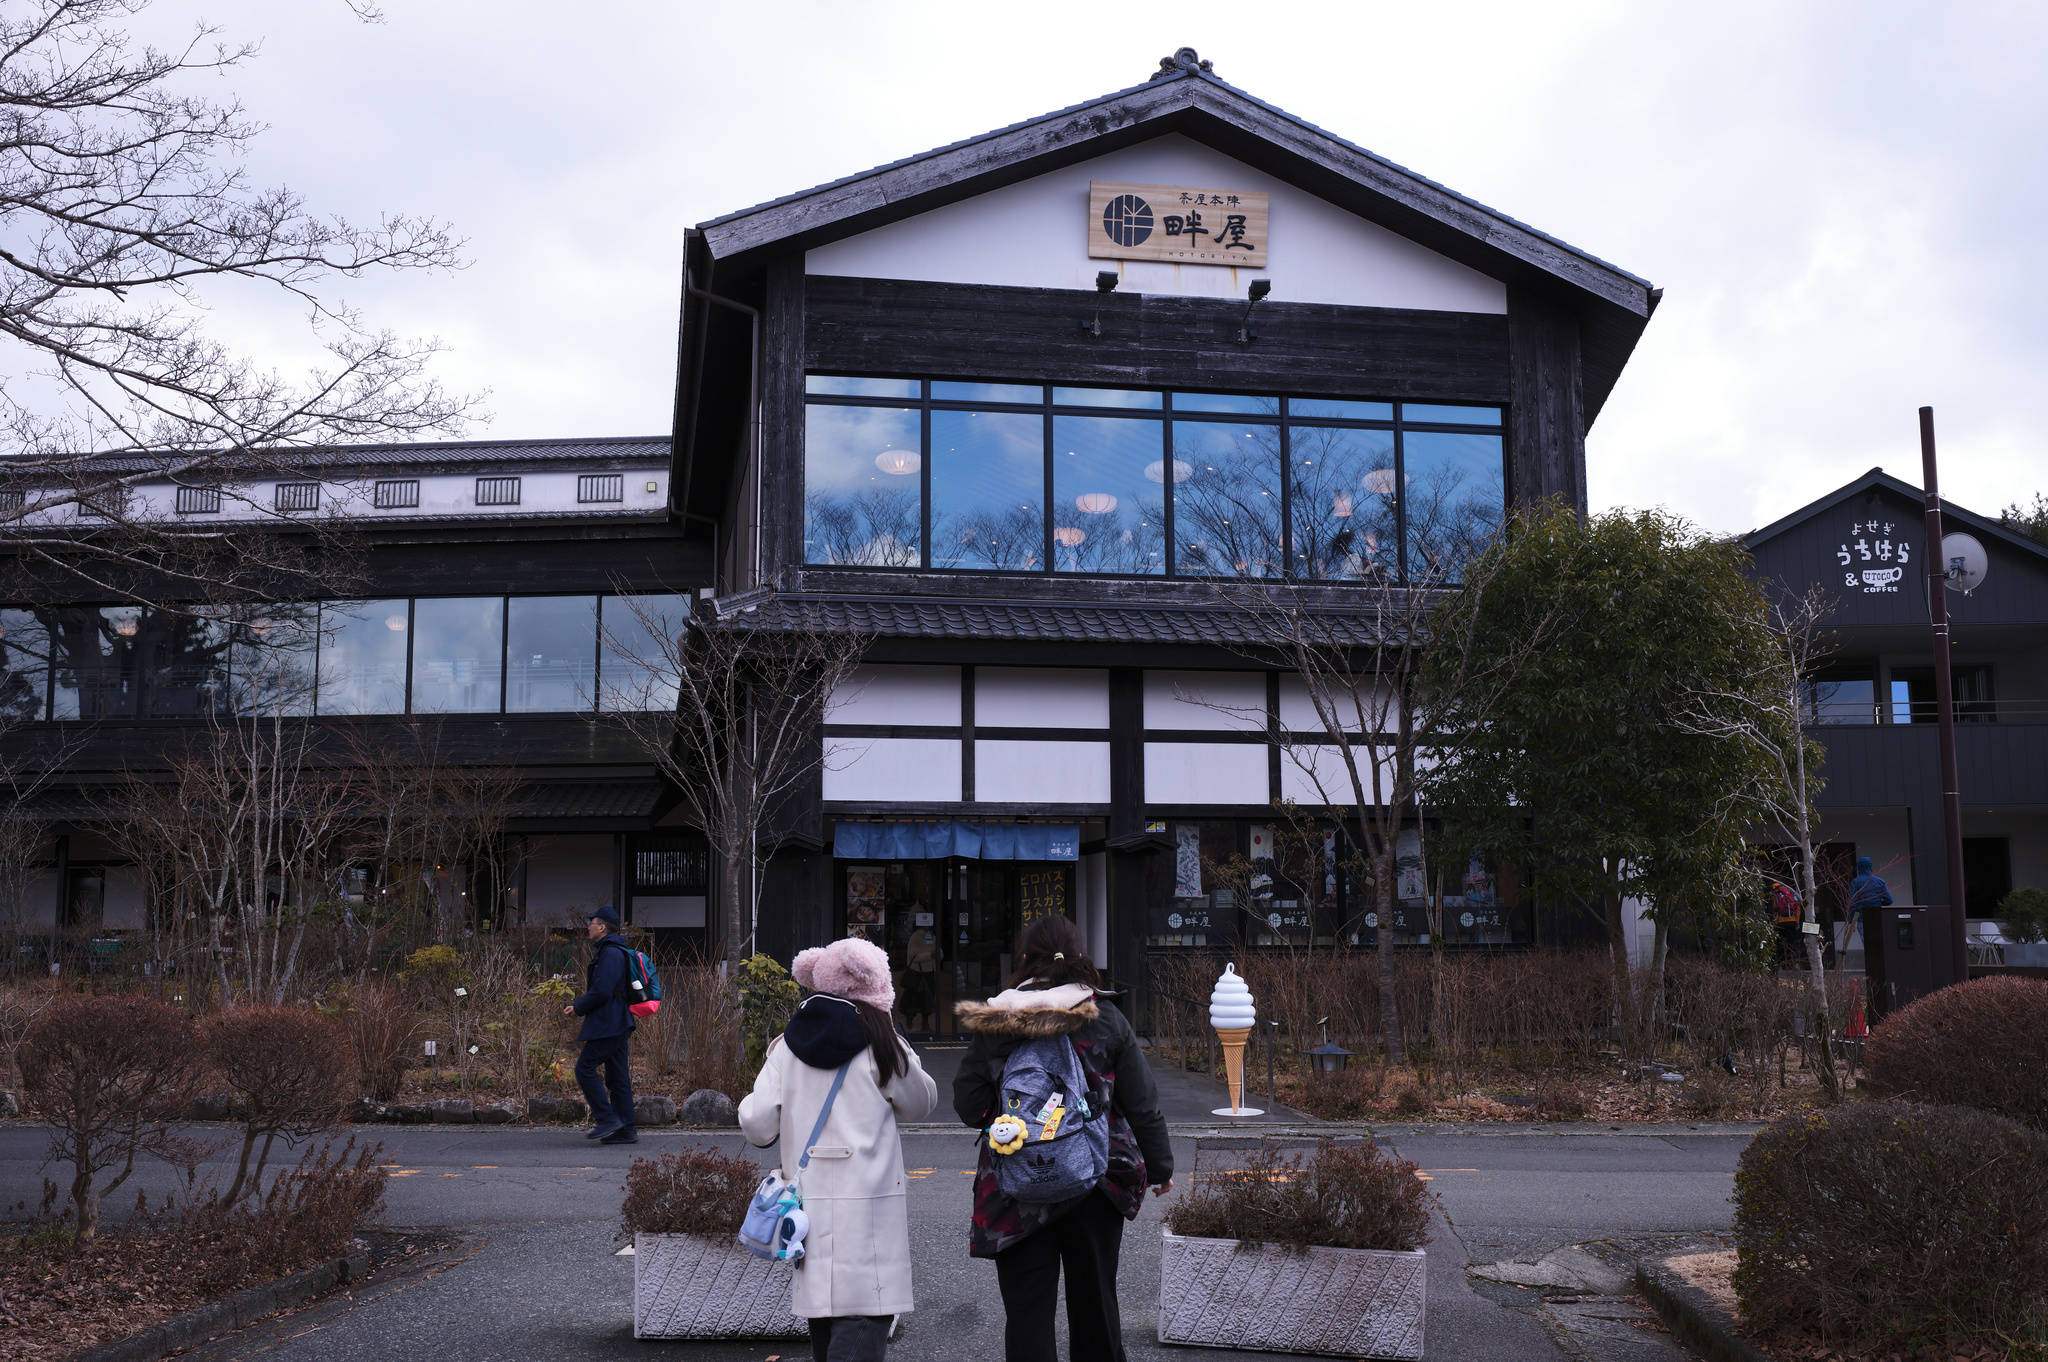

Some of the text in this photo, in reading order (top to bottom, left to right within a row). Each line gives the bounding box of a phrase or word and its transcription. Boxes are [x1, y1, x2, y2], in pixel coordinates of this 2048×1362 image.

[1179, 192, 1241, 208] 茶屋本陣
[1163, 209, 1255, 251] 畔屋
[1851, 520, 1895, 536] よせぎ
[1837, 539, 1910, 566] うちはら
[1845, 572, 1859, 587] &
[1030, 873, 1043, 920] ロースト
[1031, 1170, 1060, 1184] adidas
